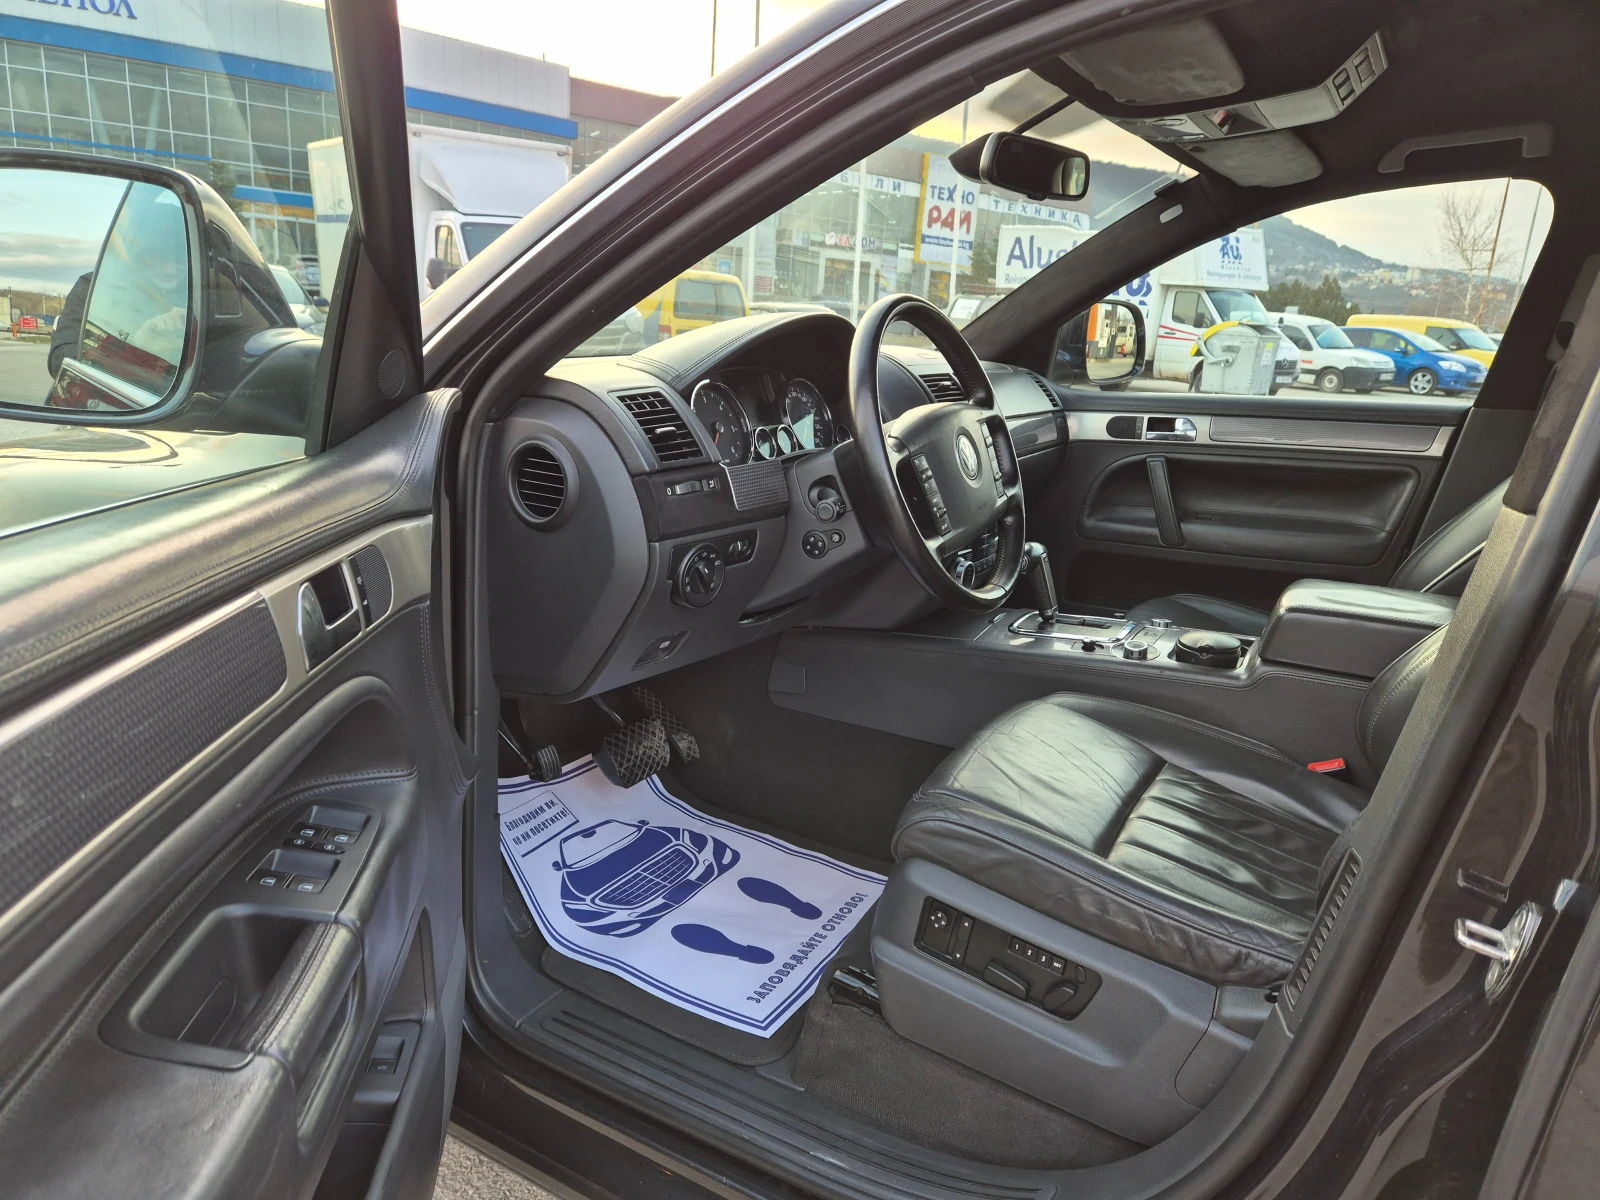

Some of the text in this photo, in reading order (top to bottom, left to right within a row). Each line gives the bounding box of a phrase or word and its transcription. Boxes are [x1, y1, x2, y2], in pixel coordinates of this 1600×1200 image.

[993, 200, 1083, 229] ТЕХНИКА
[504, 805, 547, 832] Благодарим
[529, 807, 570, 836] посетихте!
[746, 892, 868, 1004] ЗАПОВЯДАЙТЕ ОТНОВО!
